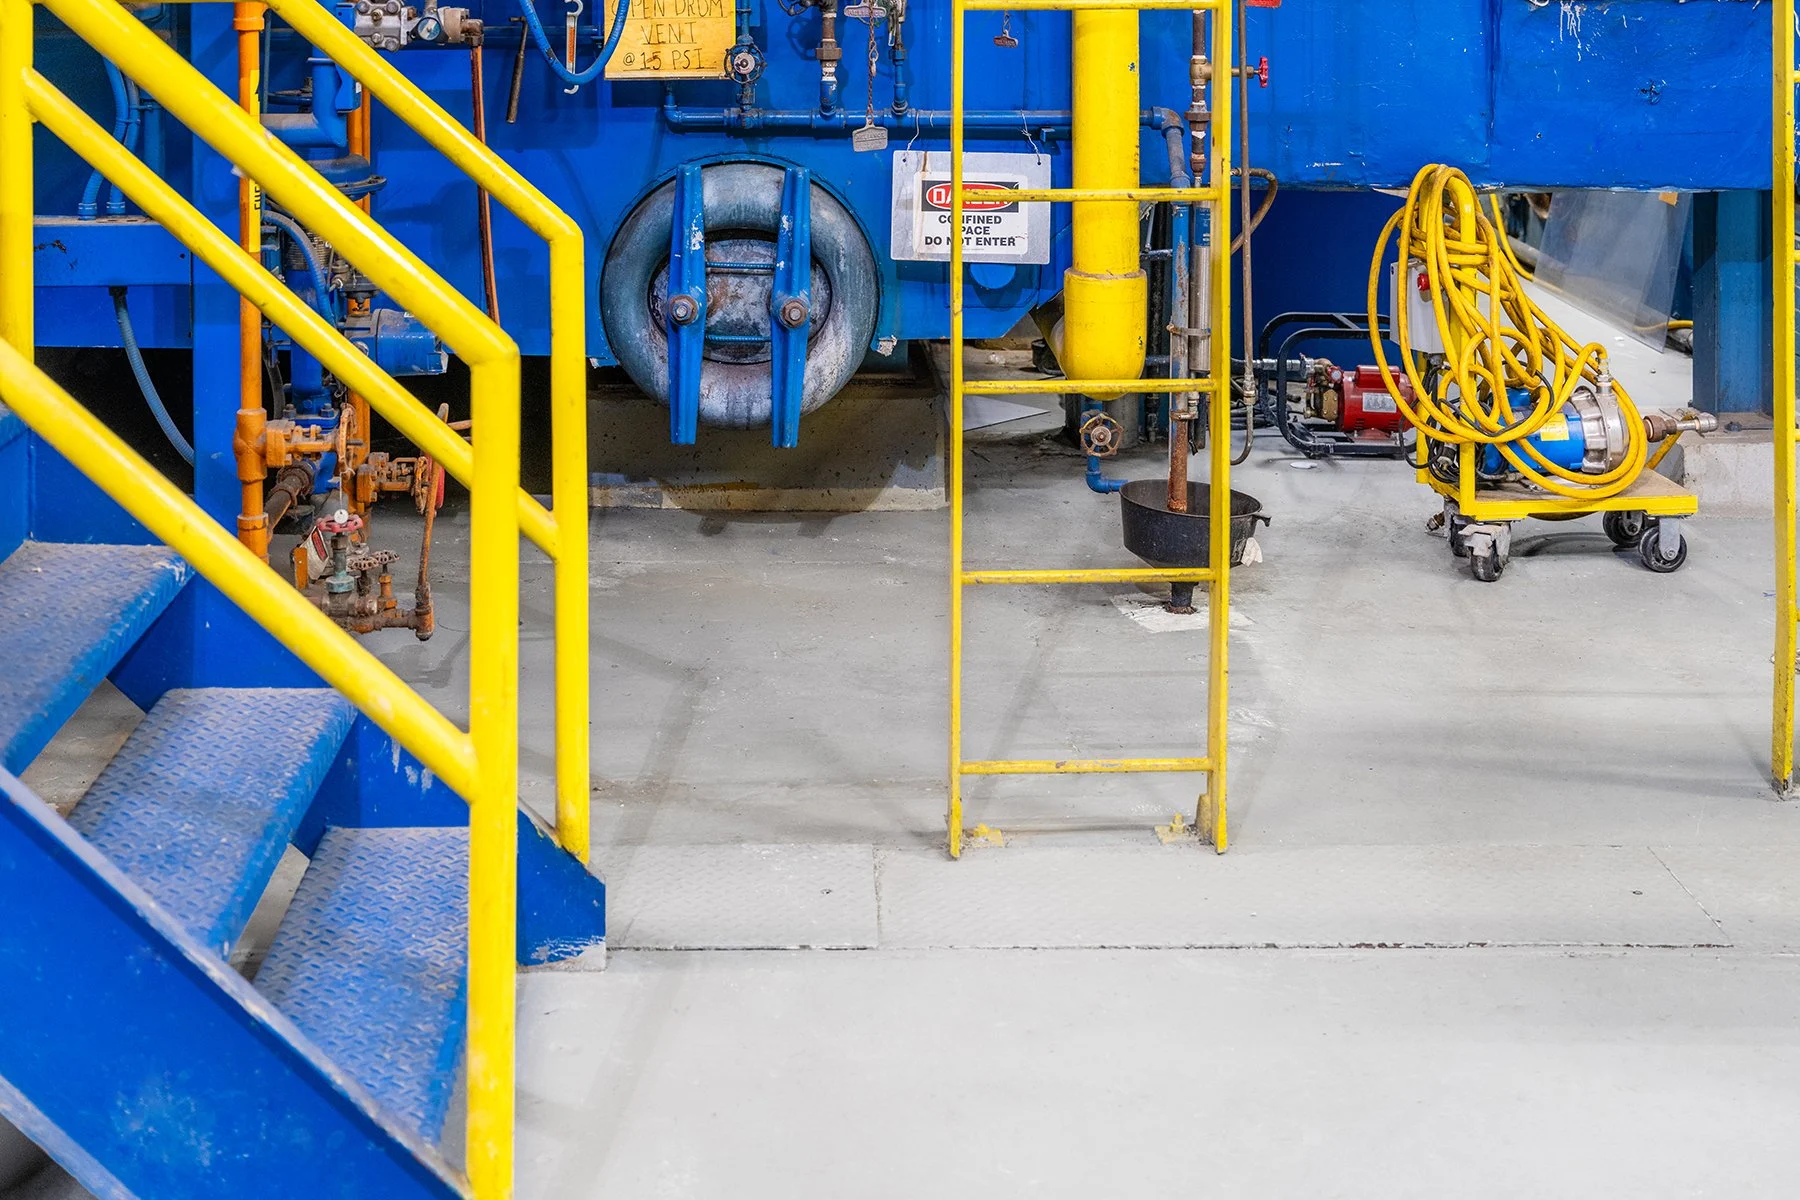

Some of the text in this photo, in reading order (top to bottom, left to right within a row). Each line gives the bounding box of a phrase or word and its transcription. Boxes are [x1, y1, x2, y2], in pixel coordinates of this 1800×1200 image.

[641, 22, 697, 45] VENT
[672, 48, 704, 70] PSI
[938, 214, 1002, 225] CFINED
[956, 226, 990, 235] PACE
[925, 237, 942, 246] DO
[975, 237, 1016, 247] ENTER
